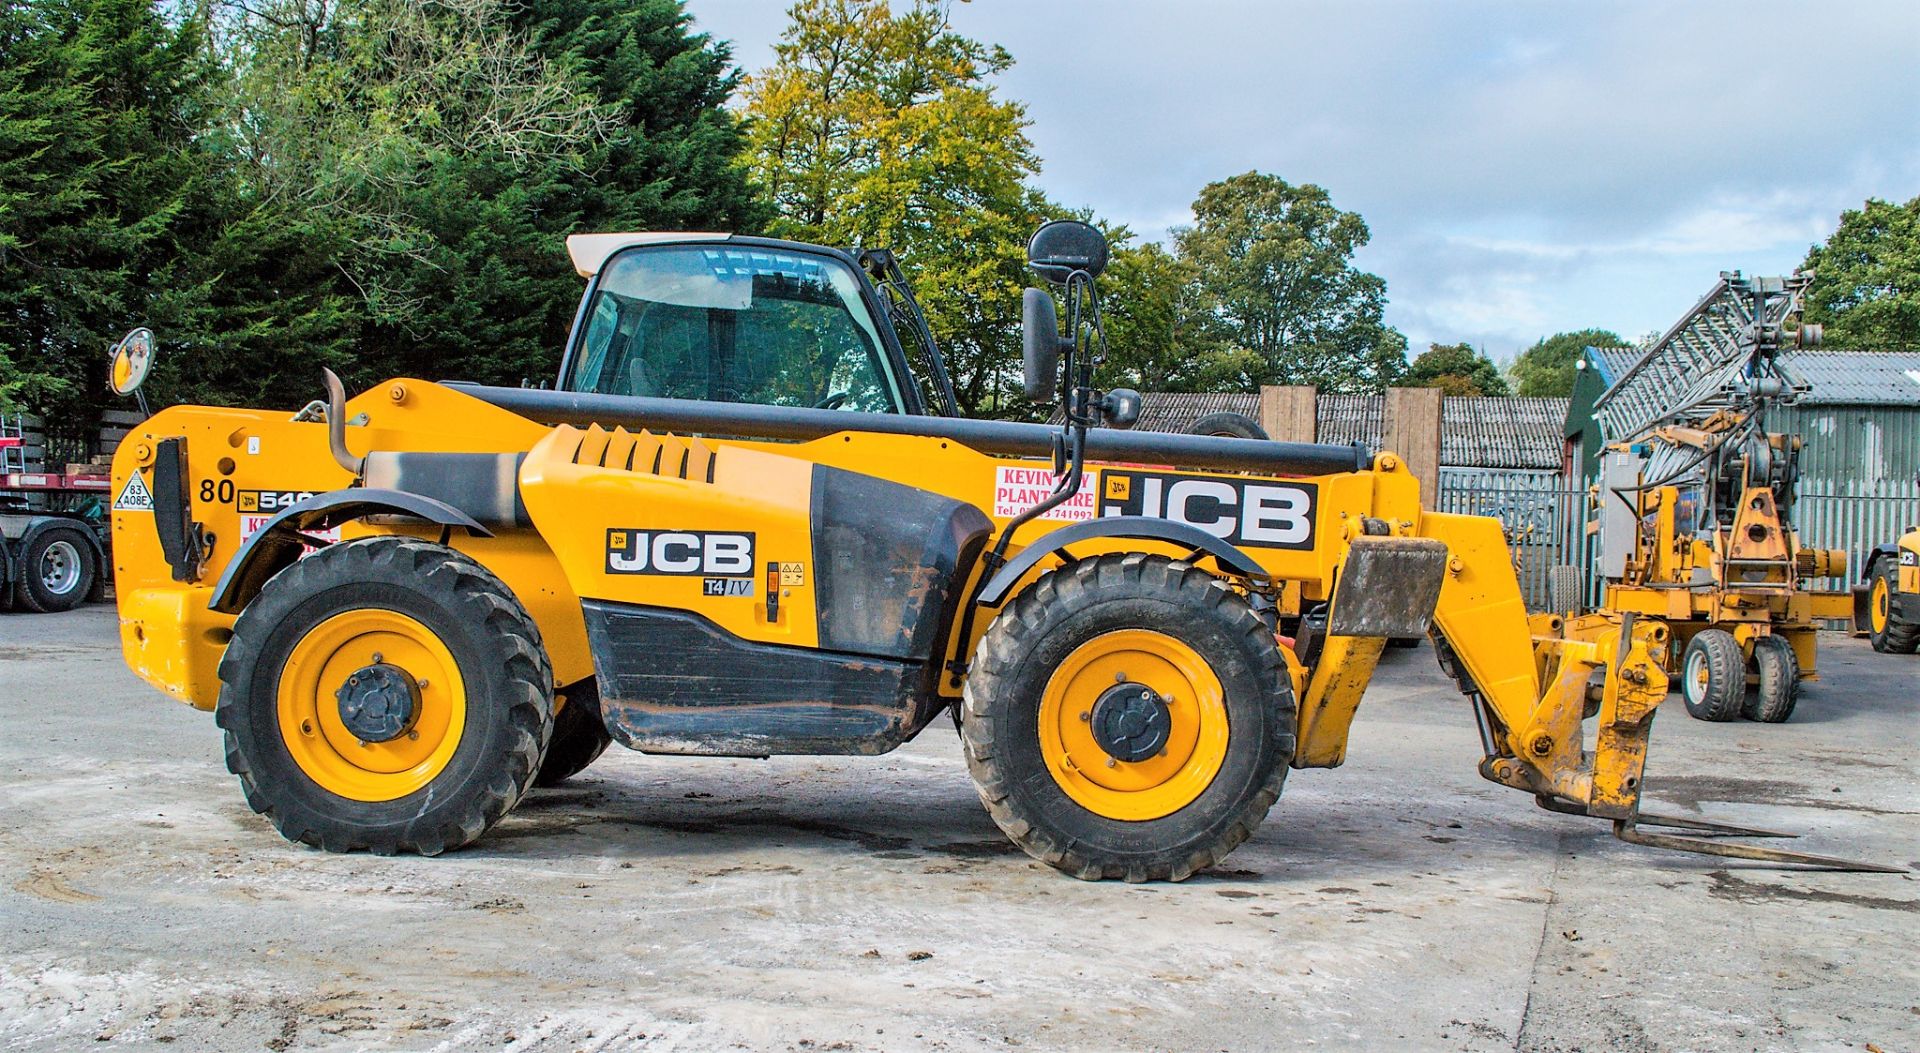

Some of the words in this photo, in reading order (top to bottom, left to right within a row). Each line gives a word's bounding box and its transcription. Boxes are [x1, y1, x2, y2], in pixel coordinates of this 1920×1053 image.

[1004, 469, 1053, 486] KEVIN
[129, 485, 142, 495] 83
[200, 479, 234, 504] 80
[997, 487, 1051, 504] PLANT
[1060, 492, 1094, 508] IRE
[123, 496, 148, 506] A08E
[997, 506, 1016, 516] Tel.
[1055, 509, 1092, 520] 741992
[1104, 478, 1311, 544] JCB
[609, 532, 752, 574] JCB
[705, 579, 724, 595] T4
[728, 580, 751, 595] IV
